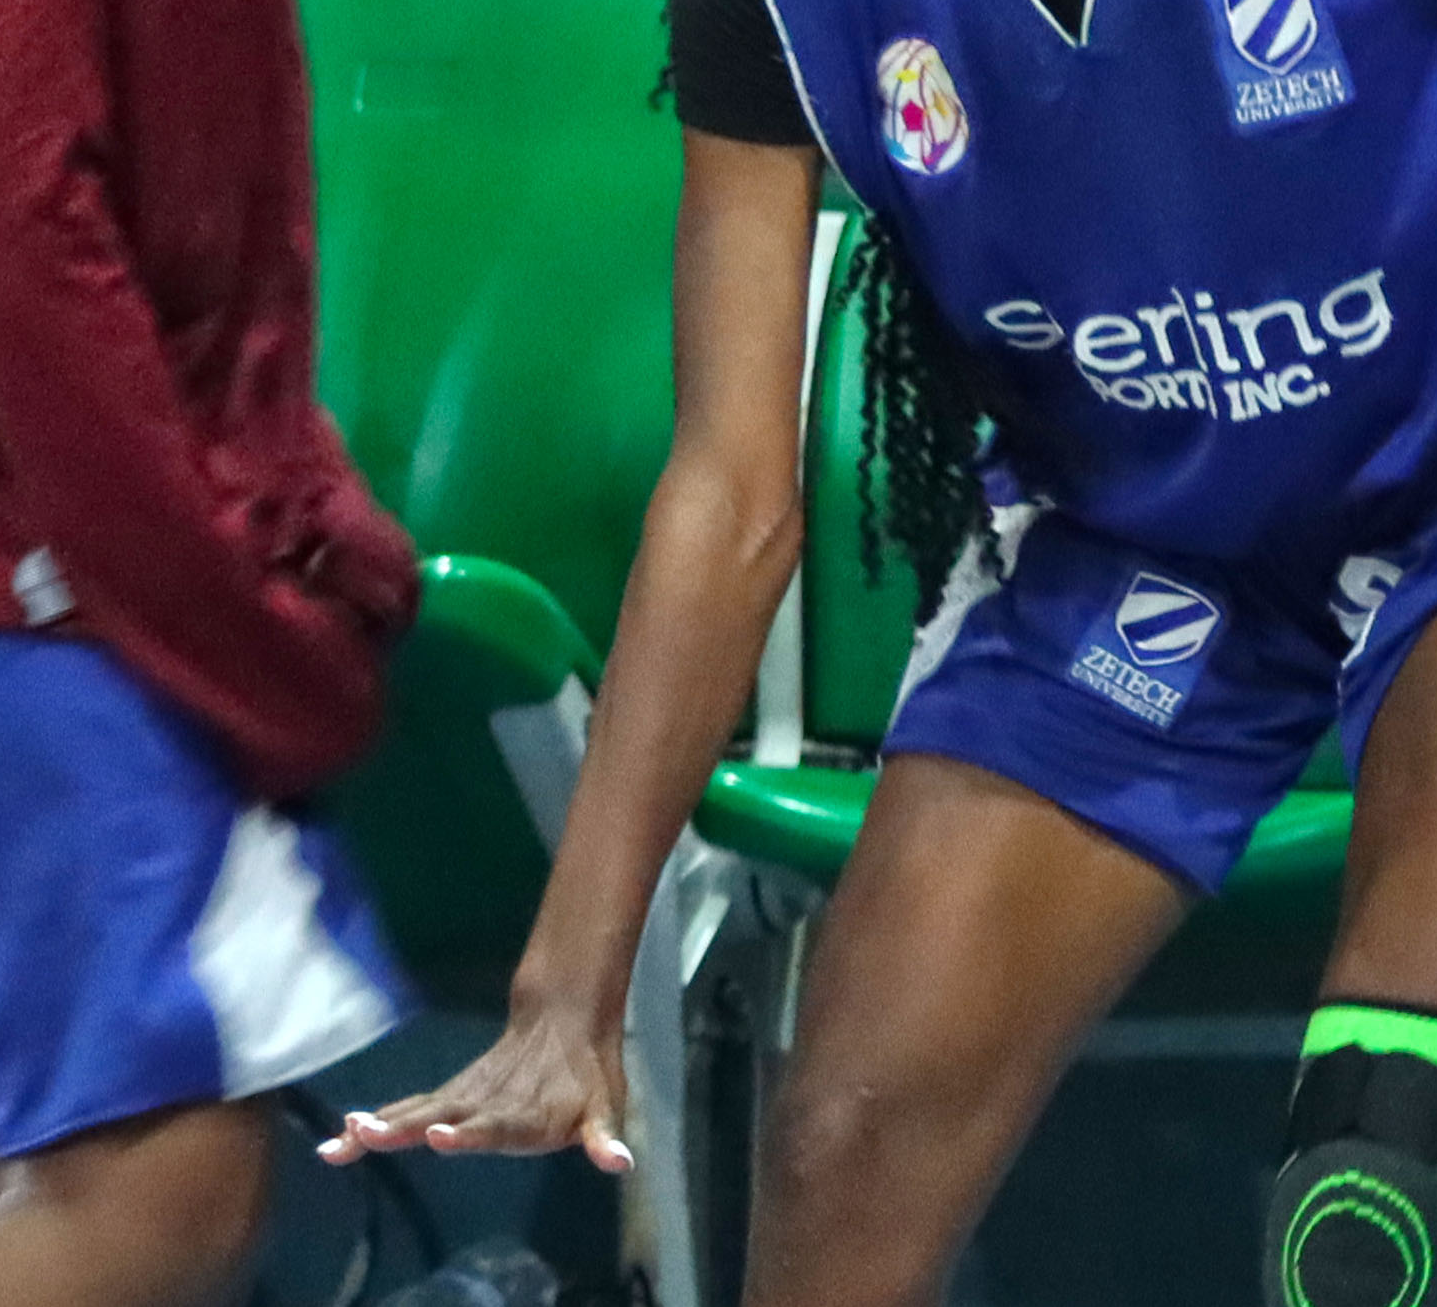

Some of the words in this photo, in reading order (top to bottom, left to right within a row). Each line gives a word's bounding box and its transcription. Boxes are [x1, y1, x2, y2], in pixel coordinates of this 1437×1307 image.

[1236, 66, 1341, 107] ZETECH
[1222, 364, 1331, 422] INC.
[1081, 644, 1183, 715] ZETECH
